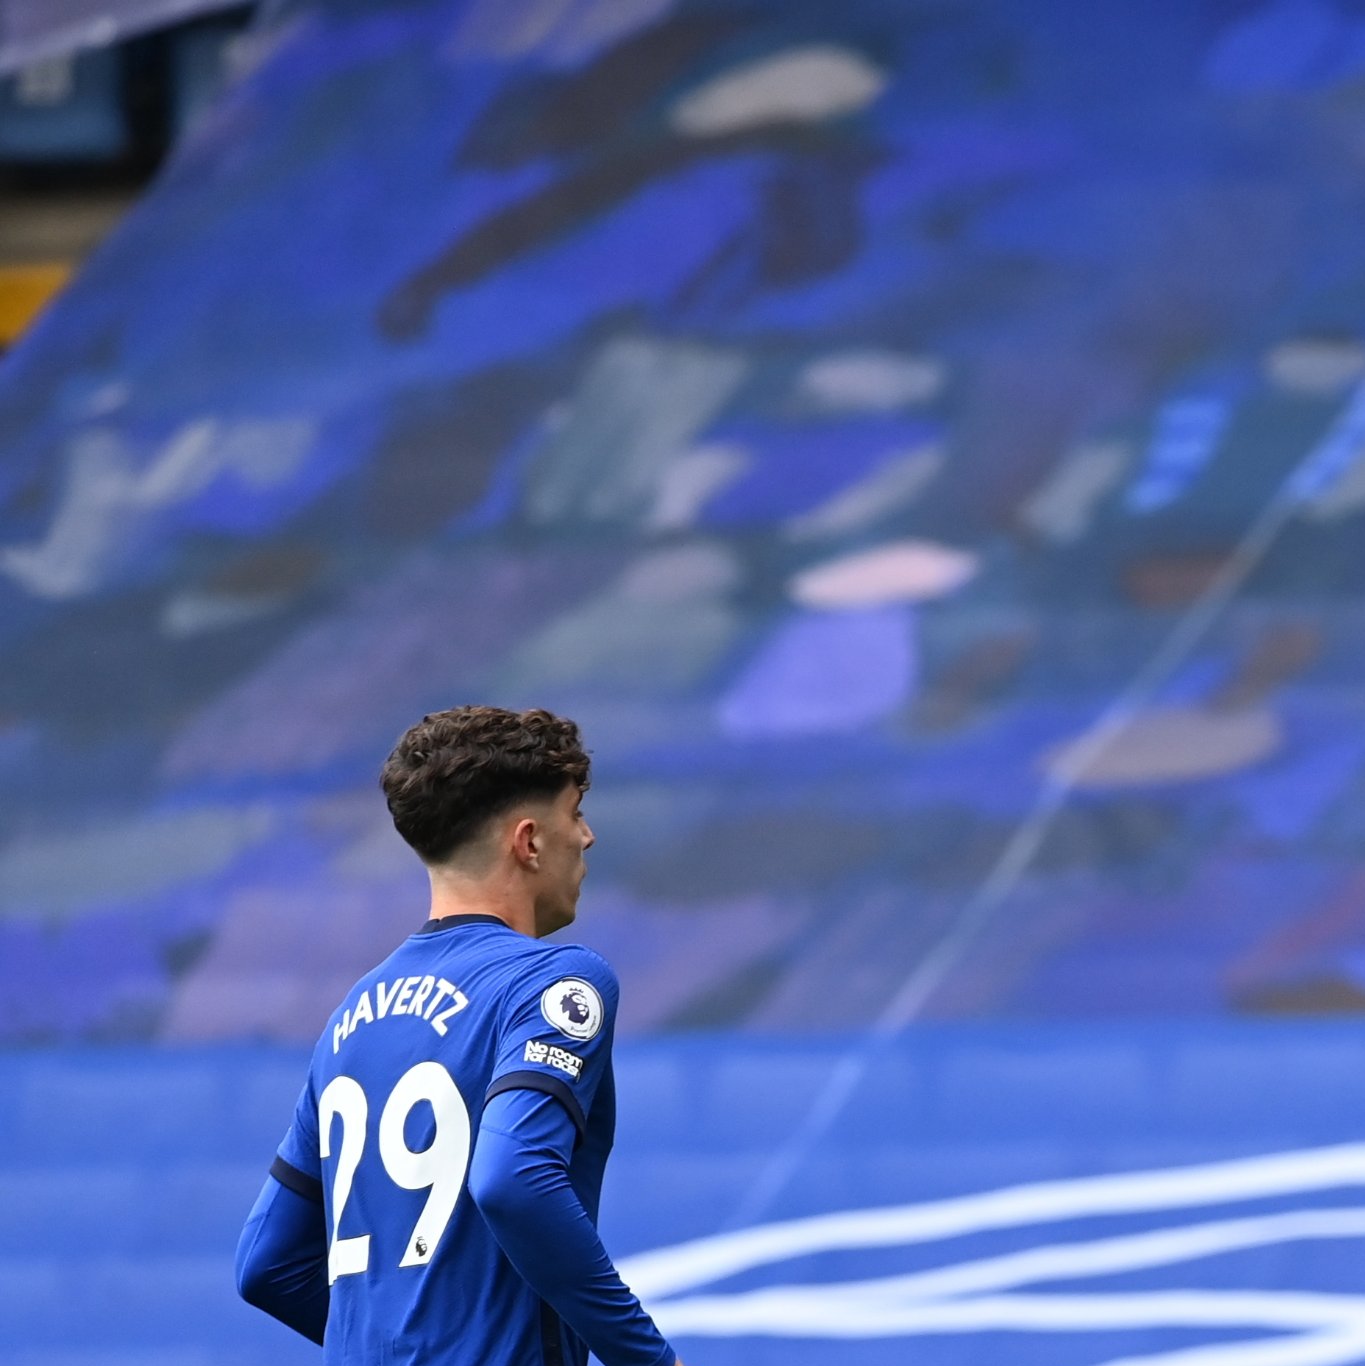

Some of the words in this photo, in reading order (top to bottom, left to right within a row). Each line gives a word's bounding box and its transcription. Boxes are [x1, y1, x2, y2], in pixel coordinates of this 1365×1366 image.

[333, 975, 469, 1054] HAVERTZ
[525, 1040, 549, 1054] No
[319, 1061, 471, 1286] 29
